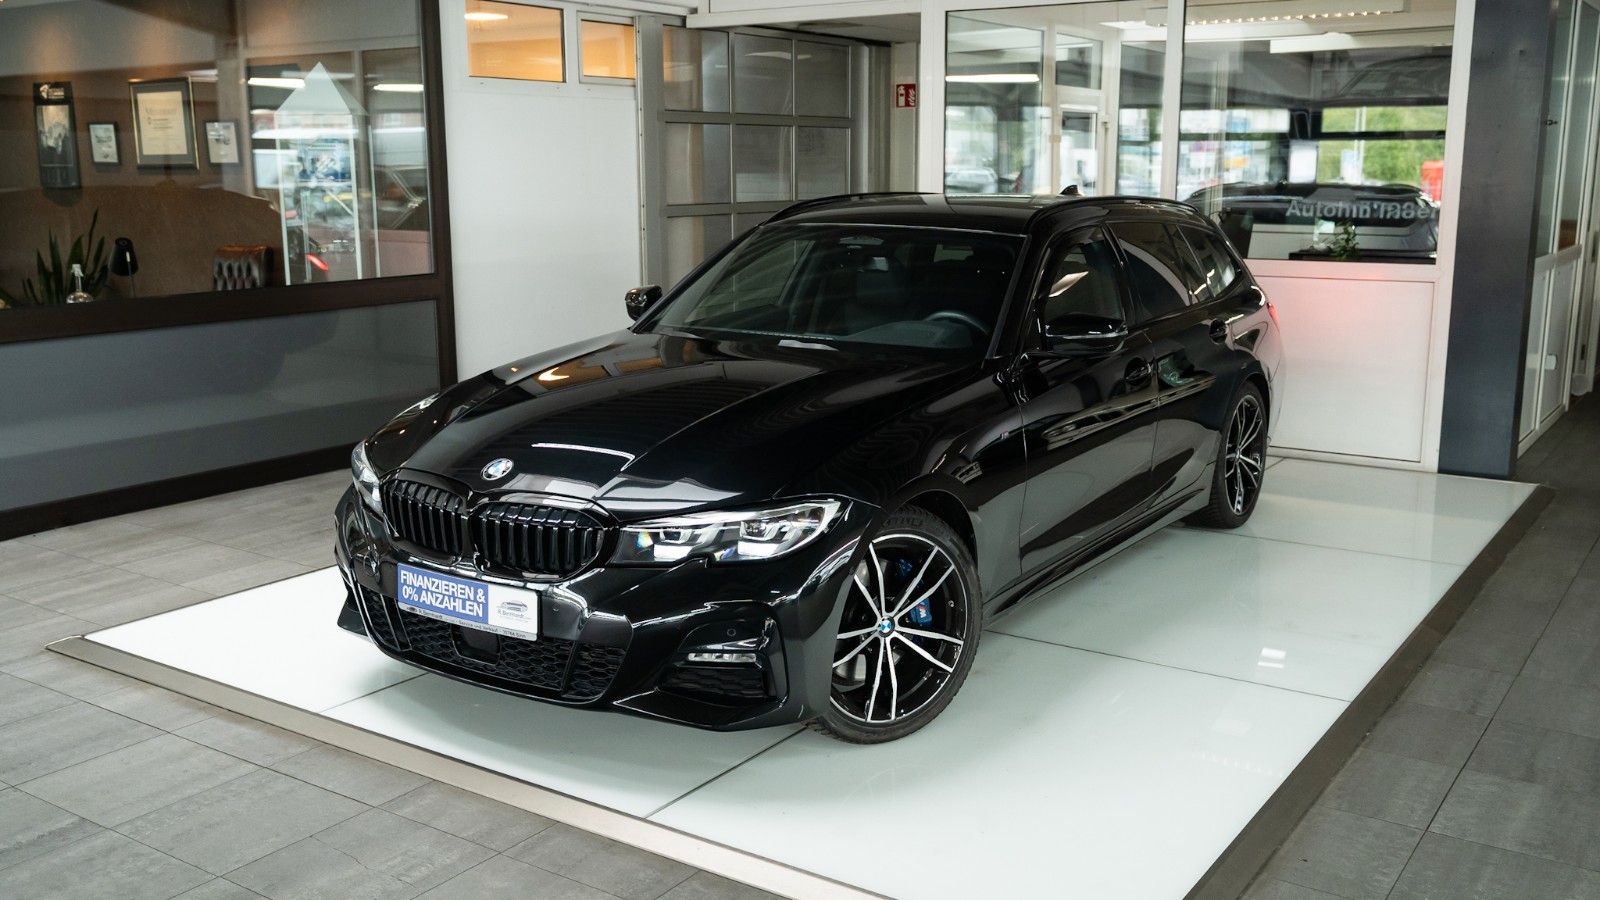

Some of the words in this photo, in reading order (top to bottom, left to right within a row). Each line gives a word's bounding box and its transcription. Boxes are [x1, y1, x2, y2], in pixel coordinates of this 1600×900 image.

[401, 570, 474, 600] FINANZIEREN
[476, 588, 486, 603] &
[402, 585, 419, 602] 0%
[420, 590, 483, 617] ANZAHLEN
